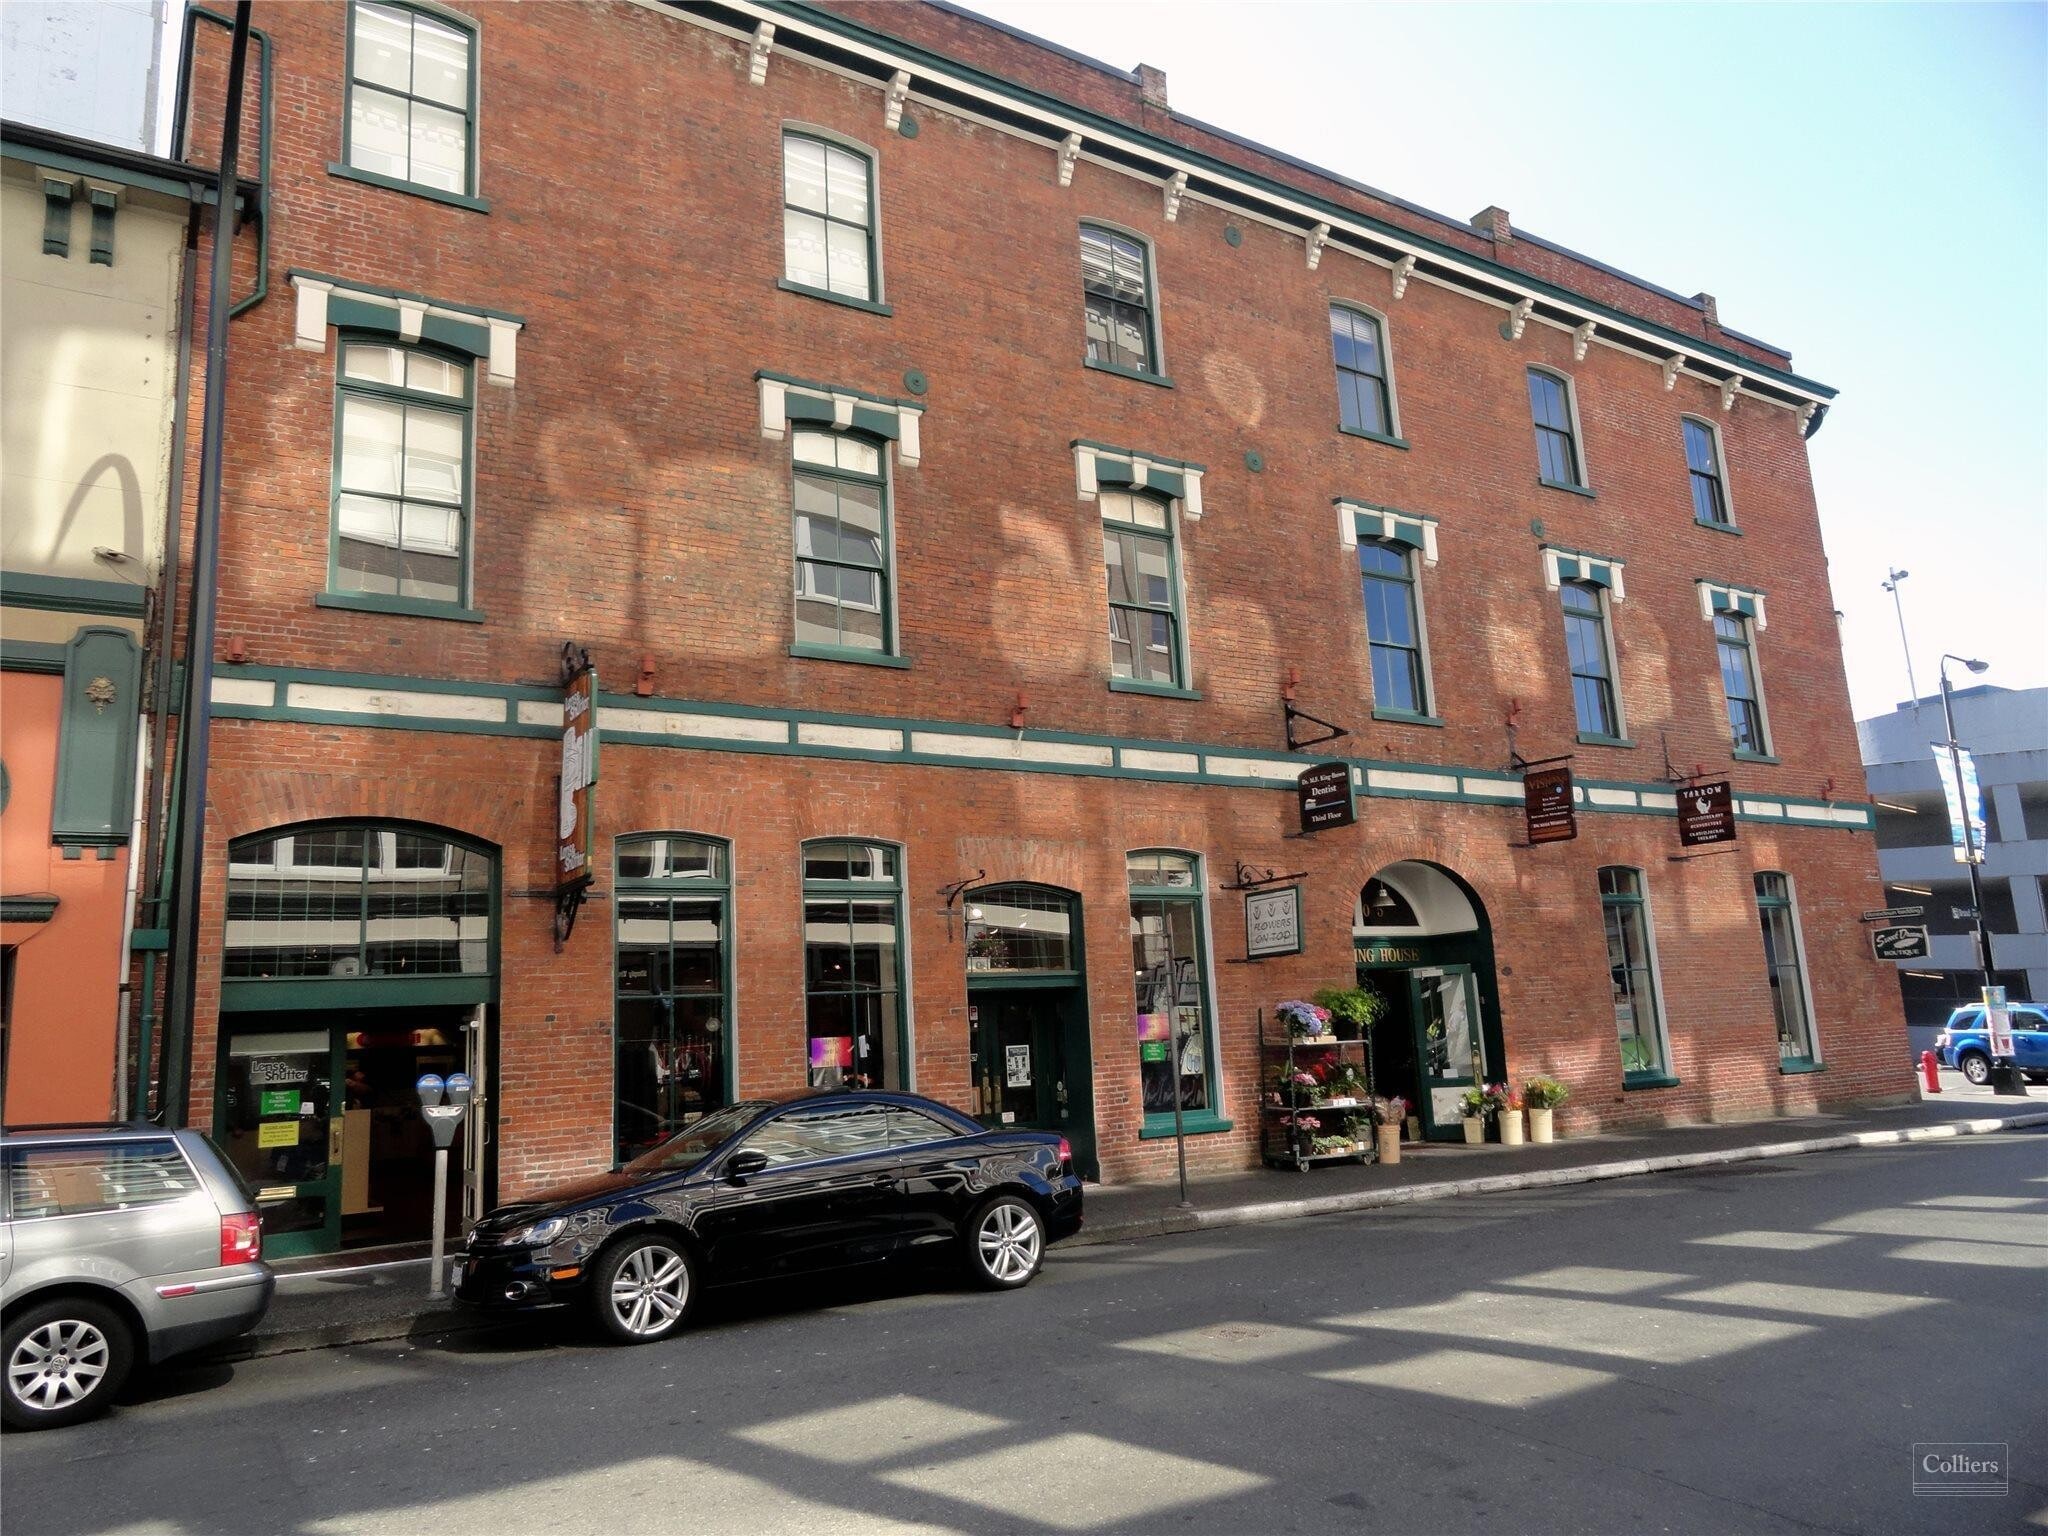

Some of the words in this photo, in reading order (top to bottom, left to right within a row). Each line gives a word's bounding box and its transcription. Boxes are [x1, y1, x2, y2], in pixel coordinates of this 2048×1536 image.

[1311, 784, 1337, 796] Dentist
[1683, 785, 1722, 799] YARROW
[1311, 813, 1327, 822] Third
[1327, 812, 1342, 820] Floor
[1380, 948, 1420, 961] HOUSE
[264, 1068, 308, 1081] Shutter
